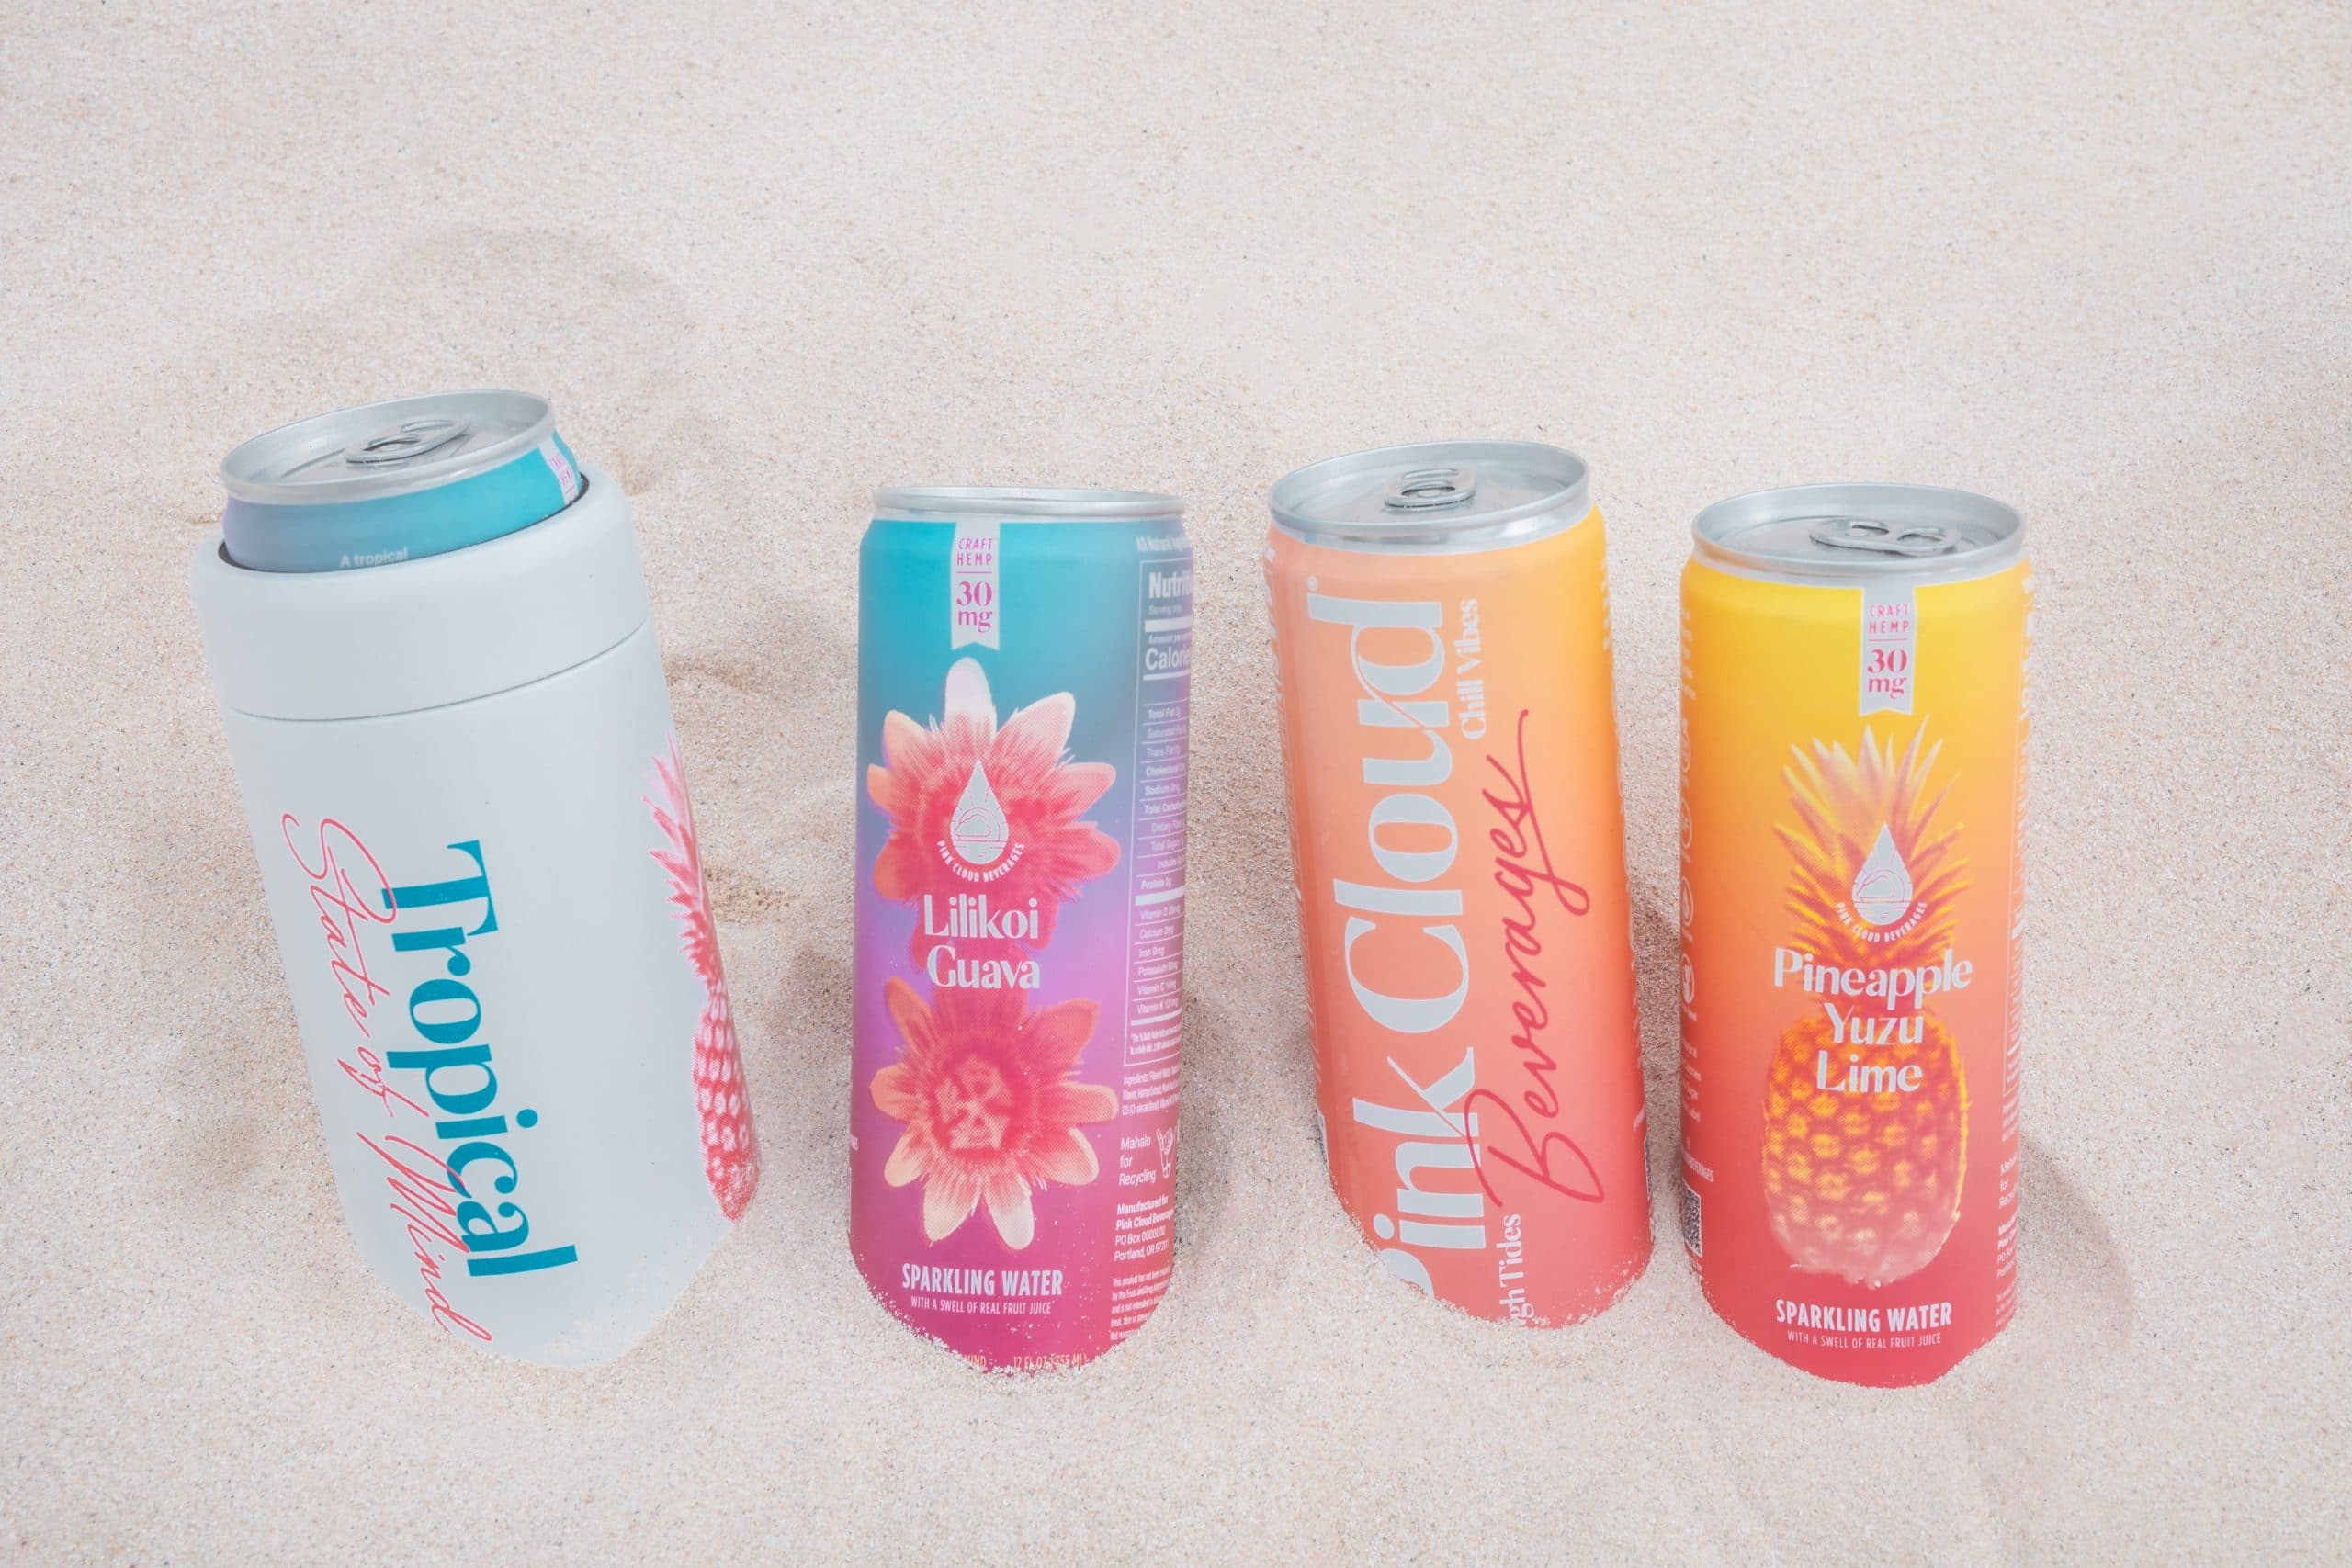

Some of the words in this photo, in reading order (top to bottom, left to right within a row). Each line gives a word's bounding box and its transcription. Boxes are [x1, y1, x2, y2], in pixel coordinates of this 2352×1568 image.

[339, 553, 351, 569] A
[352, 546, 409, 567] tropical
[956, 552, 992, 566] HEMP
[958, 537, 993, 550] CRAFT
[956, 581, 992, 607] 30
[1869, 604, 1909, 617] CRAFT
[957, 610, 993, 633] mg
[1453, 597, 1482, 675] Vibes
[1869, 620, 1909, 634] HEMP
[1867, 648, 1908, 673] 30
[1867, 676, 1907, 699] mg
[1456, 678, 1487, 739] Chill
[1306, 593, 1470, 1034] Cloud
[936, 840, 954, 865] PINK
[952, 862, 980, 883] CLOUD
[982, 842, 1026, 883] BEVERAGES
[282, 813, 396, 1038] State
[924, 893, 1039, 939] Lilikoi
[1836, 902, 1853, 926] PINK
[1851, 924, 1881, 942] CLOUD
[1883, 901, 1927, 942] BEVERAGES
[926, 944, 1041, 989] Guava
[1464, 709, 1604, 1208] Beverages
[1773, 947, 1973, 1010] Pineapple
[1824, 1002, 1923, 1045] Yuzu
[381, 839, 579, 1277] Tropical
[1816, 1050, 1923, 1093] Lime
[337, 1045, 430, 1118] of
[1121, 1134, 1151, 1151] Mahalo
[1120, 1154, 1133, 1168] for
[1119, 1168, 1156, 1188] Recycling
[1115, 1217, 1132, 1230] Pink
[1133, 1213, 1152, 1228] Cloud
[1117, 1195, 1162, 1215] Manufactured
[356, 1131, 493, 1341] Mind
[1115, 1234, 1126, 1247] PO
[1127, 1233, 1141, 1244] Box
[1496, 1213, 1525, 1288] Tides
[902, 1263, 996, 1296] SPARKLING
[1001, 1269, 1063, 1296] WATER
[910, 1296, 930, 1309] WITH
[932, 1299, 937, 1310] A
[940, 1299, 965, 1313] SWELL
[967, 1301, 978, 1314] OF
[980, 1302, 1001, 1314] REAL
[1003, 1303, 1026, 1314] FRUIT
[1029, 1302, 1052, 1314] JUICE
[1498, 1288, 1535, 1321] gh
[1775, 1299, 1881, 1332] SPARKLING
[1886, 1302, 1952, 1332] WATER
[1787, 1329, 1809, 1344] WITH
[1812, 1334, 1818, 1345] A
[1821, 1335, 1848, 1348] SWELL
[1851, 1337, 1863, 1349] OF
[1866, 1337, 1887, 1349] REAL
[1890, 1336, 1915, 1349] FRUIT
[1917, 1332, 1941, 1347] JUICE
